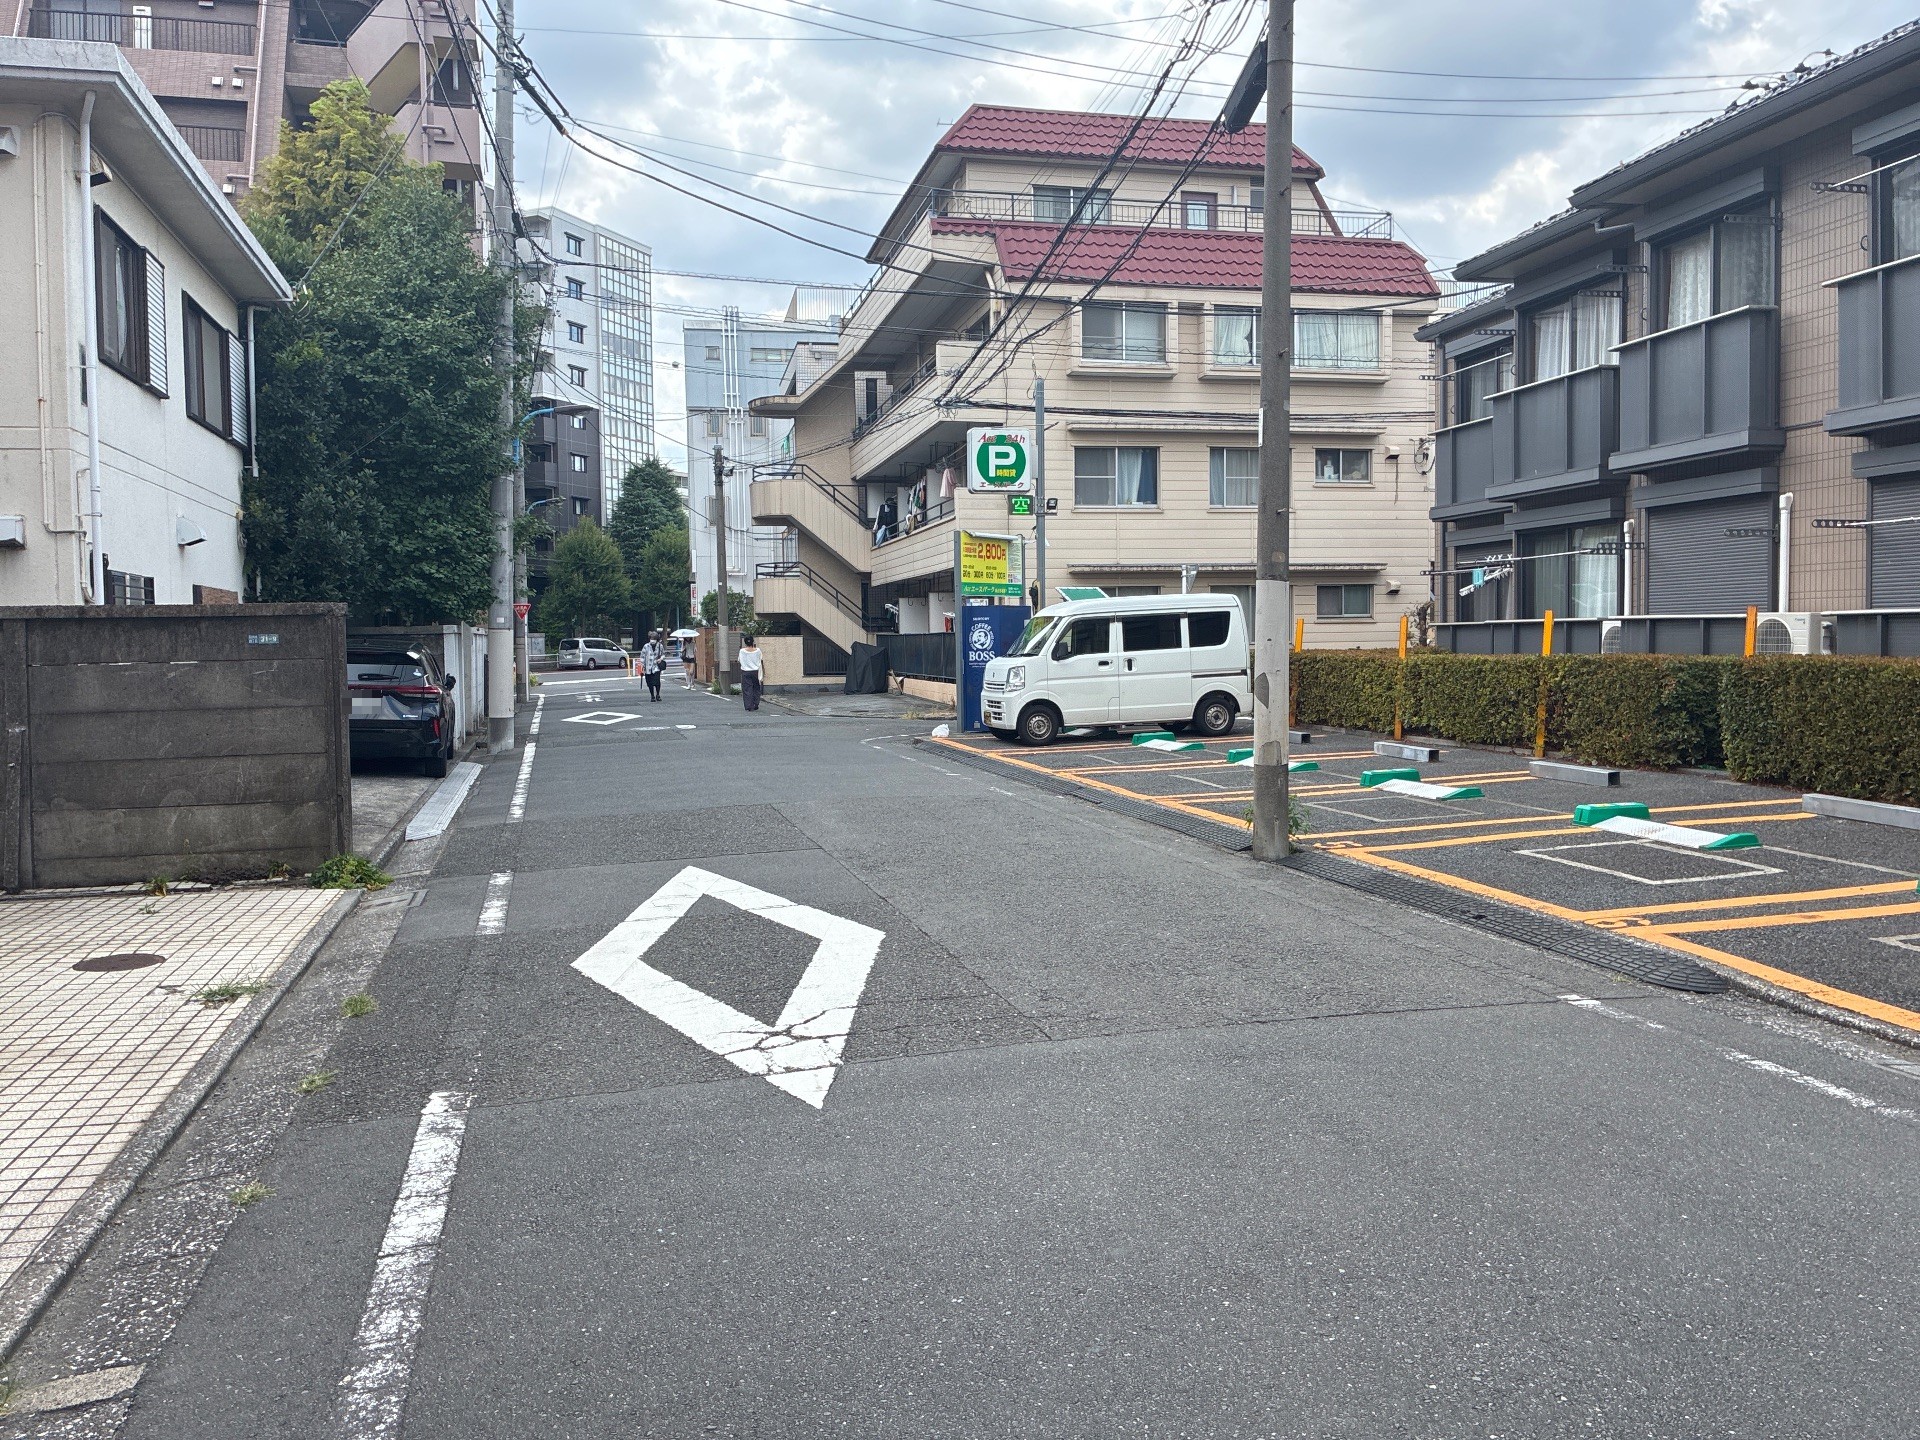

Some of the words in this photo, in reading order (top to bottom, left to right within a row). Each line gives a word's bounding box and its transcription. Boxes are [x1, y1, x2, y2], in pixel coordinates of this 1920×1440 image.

[988, 445, 1017, 478] P
[996, 469, 1017, 477] 時間貸
[1011, 496, 1031, 514] 空
[971, 622, 992, 632] COFFEE
[969, 651, 995, 661] BOSS
